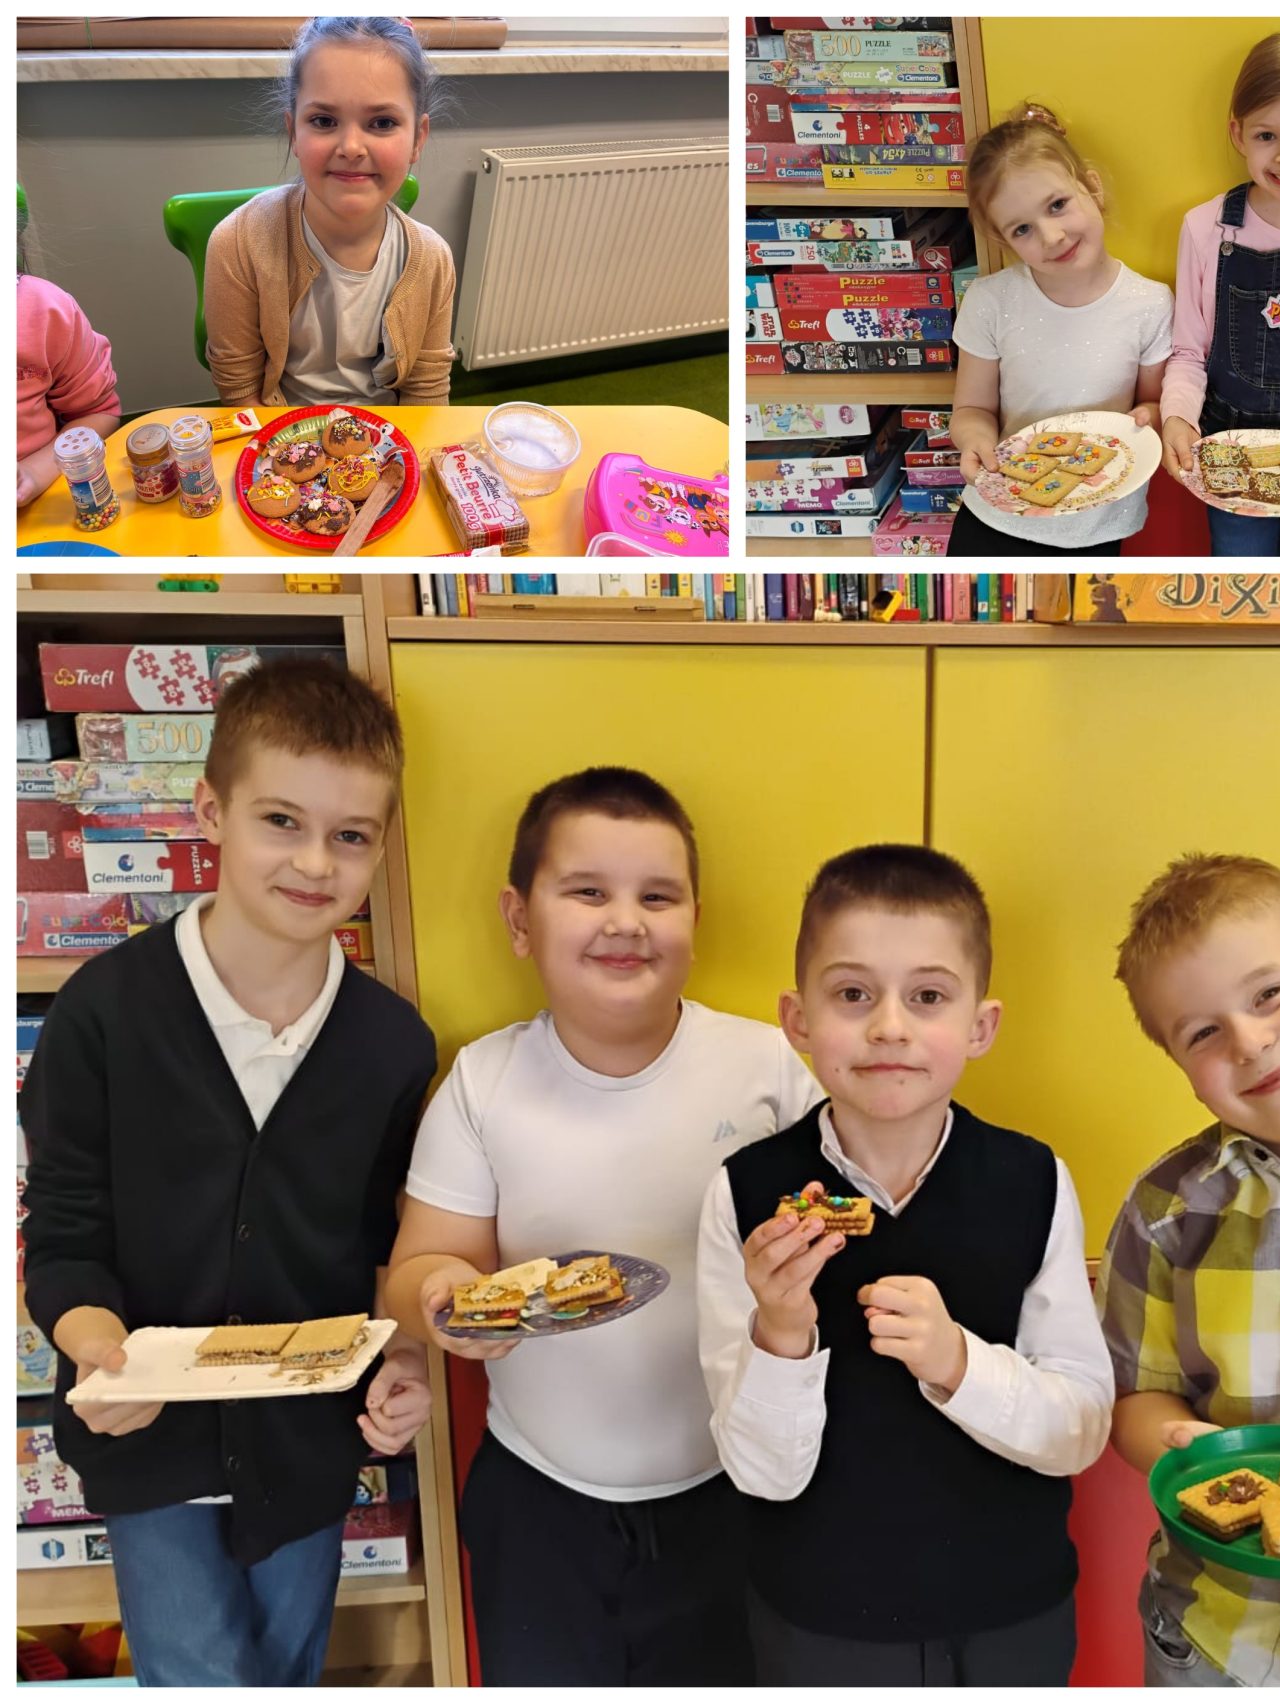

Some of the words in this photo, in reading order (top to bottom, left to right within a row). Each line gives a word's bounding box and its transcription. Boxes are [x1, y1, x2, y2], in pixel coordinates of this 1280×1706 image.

[821, 34, 862, 57] 500
[865, 40, 892, 48] PUZZLE
[843, 71, 871, 79] PUZZLE
[856, 115, 865, 141] PUZZLES
[798, 131, 841, 139] Clementoni
[786, 170, 823, 178] Clemento
[806, 245, 816, 260] 250
[840, 277, 886, 289] Puzzle
[842, 294, 889, 306] Puzzle
[761, 314, 770, 338] WARS
[767, 313, 776, 338] STAR
[800, 320, 820, 330] Trefl
[754, 355, 775, 364] Trefl
[918, 458, 930, 466] Trefl
[453, 453, 473, 481] Petit
[466, 480, 492, 520] Beurre
[835, 500, 871, 508] Clementoni
[75, 668, 115, 689] Trefl
[136, 721, 202, 755] 500
[17, 768, 44, 779] uper
[25, 783, 54, 792] Cleme
[190, 845, 203, 886] PUZZLES
[203, 858, 214, 869] 4
[92, 872, 164, 885] Clementoni
[42, 914, 86, 930] Super
[89, 914, 129, 932] Colo
[61, 934, 129, 947] Clemento
[52, 1507, 91, 1518] MEM
[342, 1558, 403, 1571] Clementoni
